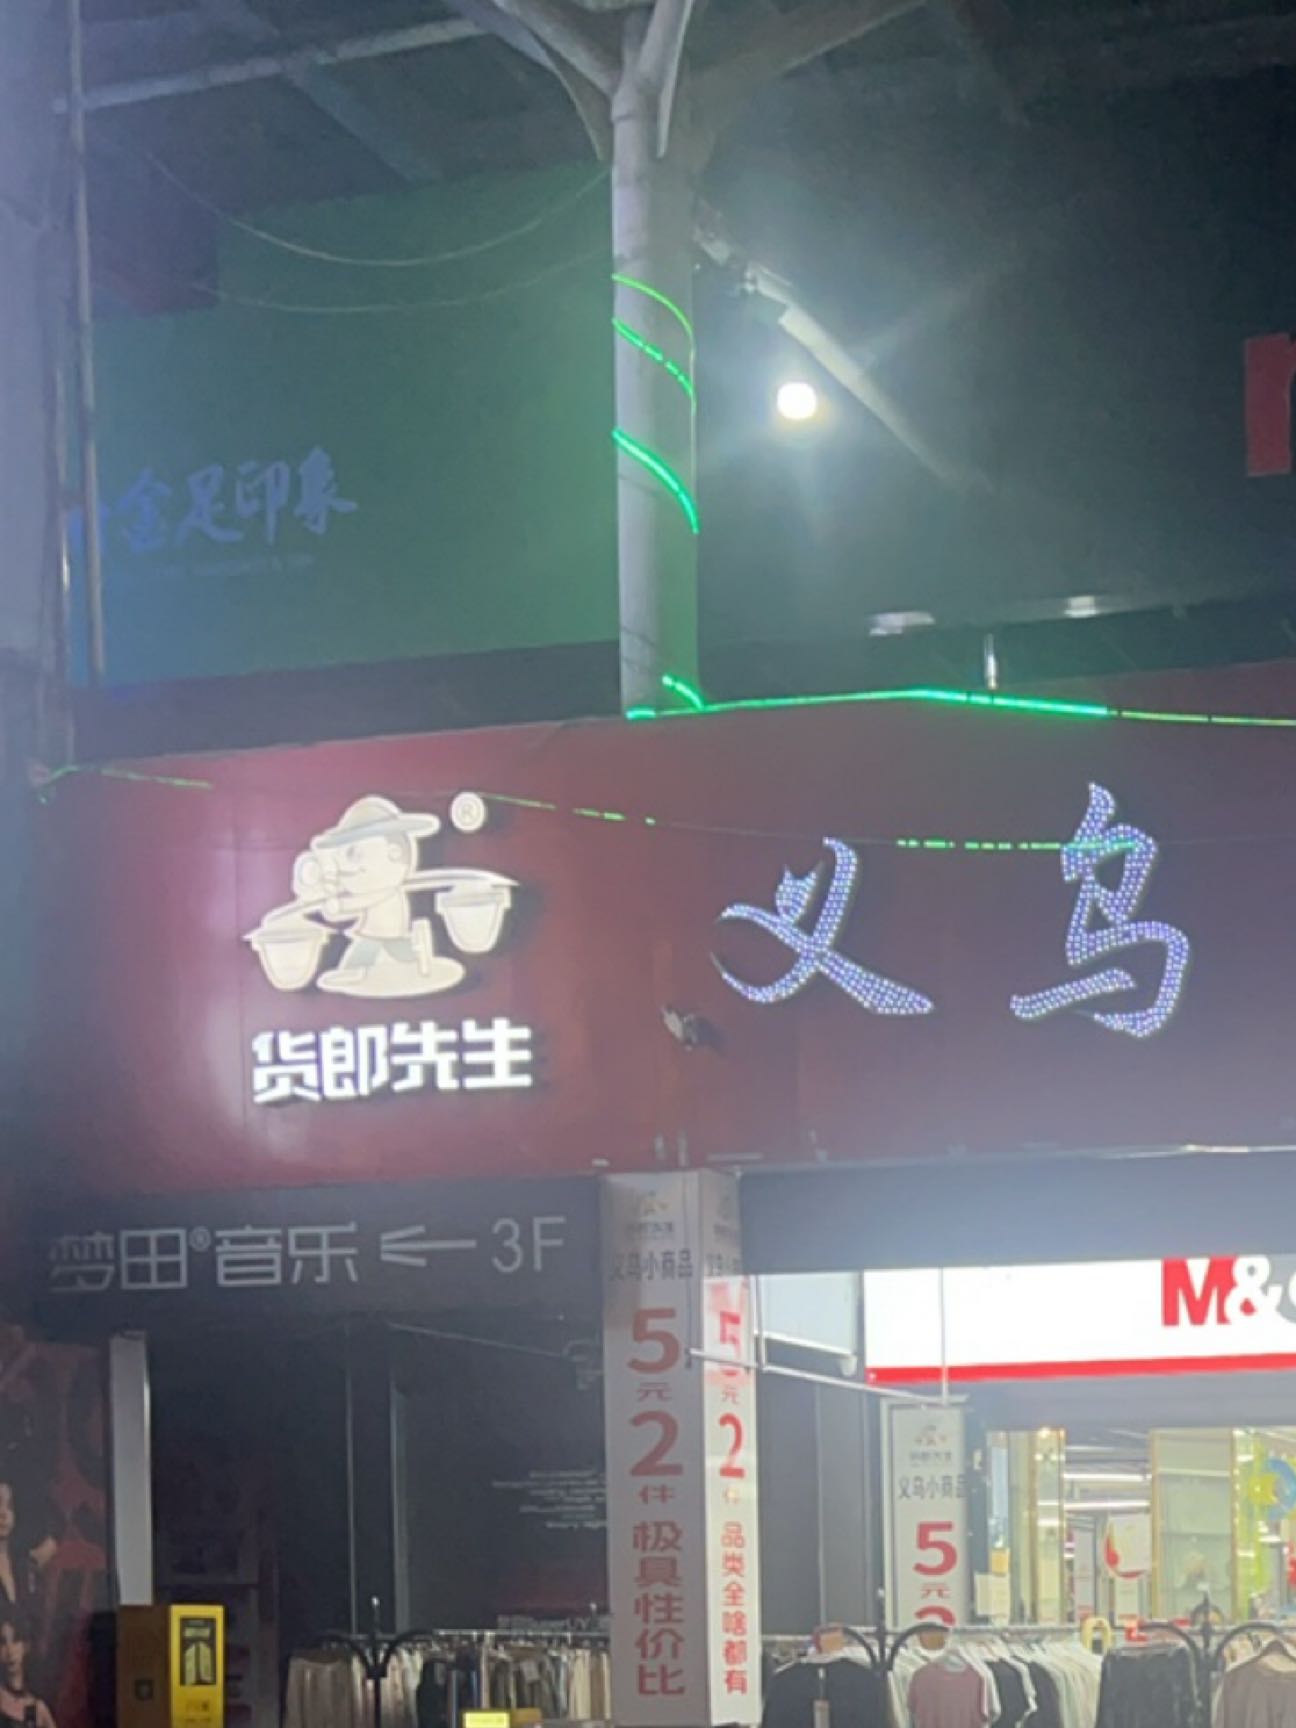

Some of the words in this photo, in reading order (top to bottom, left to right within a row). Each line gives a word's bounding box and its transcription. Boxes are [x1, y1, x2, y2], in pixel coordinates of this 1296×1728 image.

[251, 1016, 533, 1103] 货郎先生
[491, 1215, 567, 1275] 3F
[632, 1520, 686, 1695] 极具性价比
